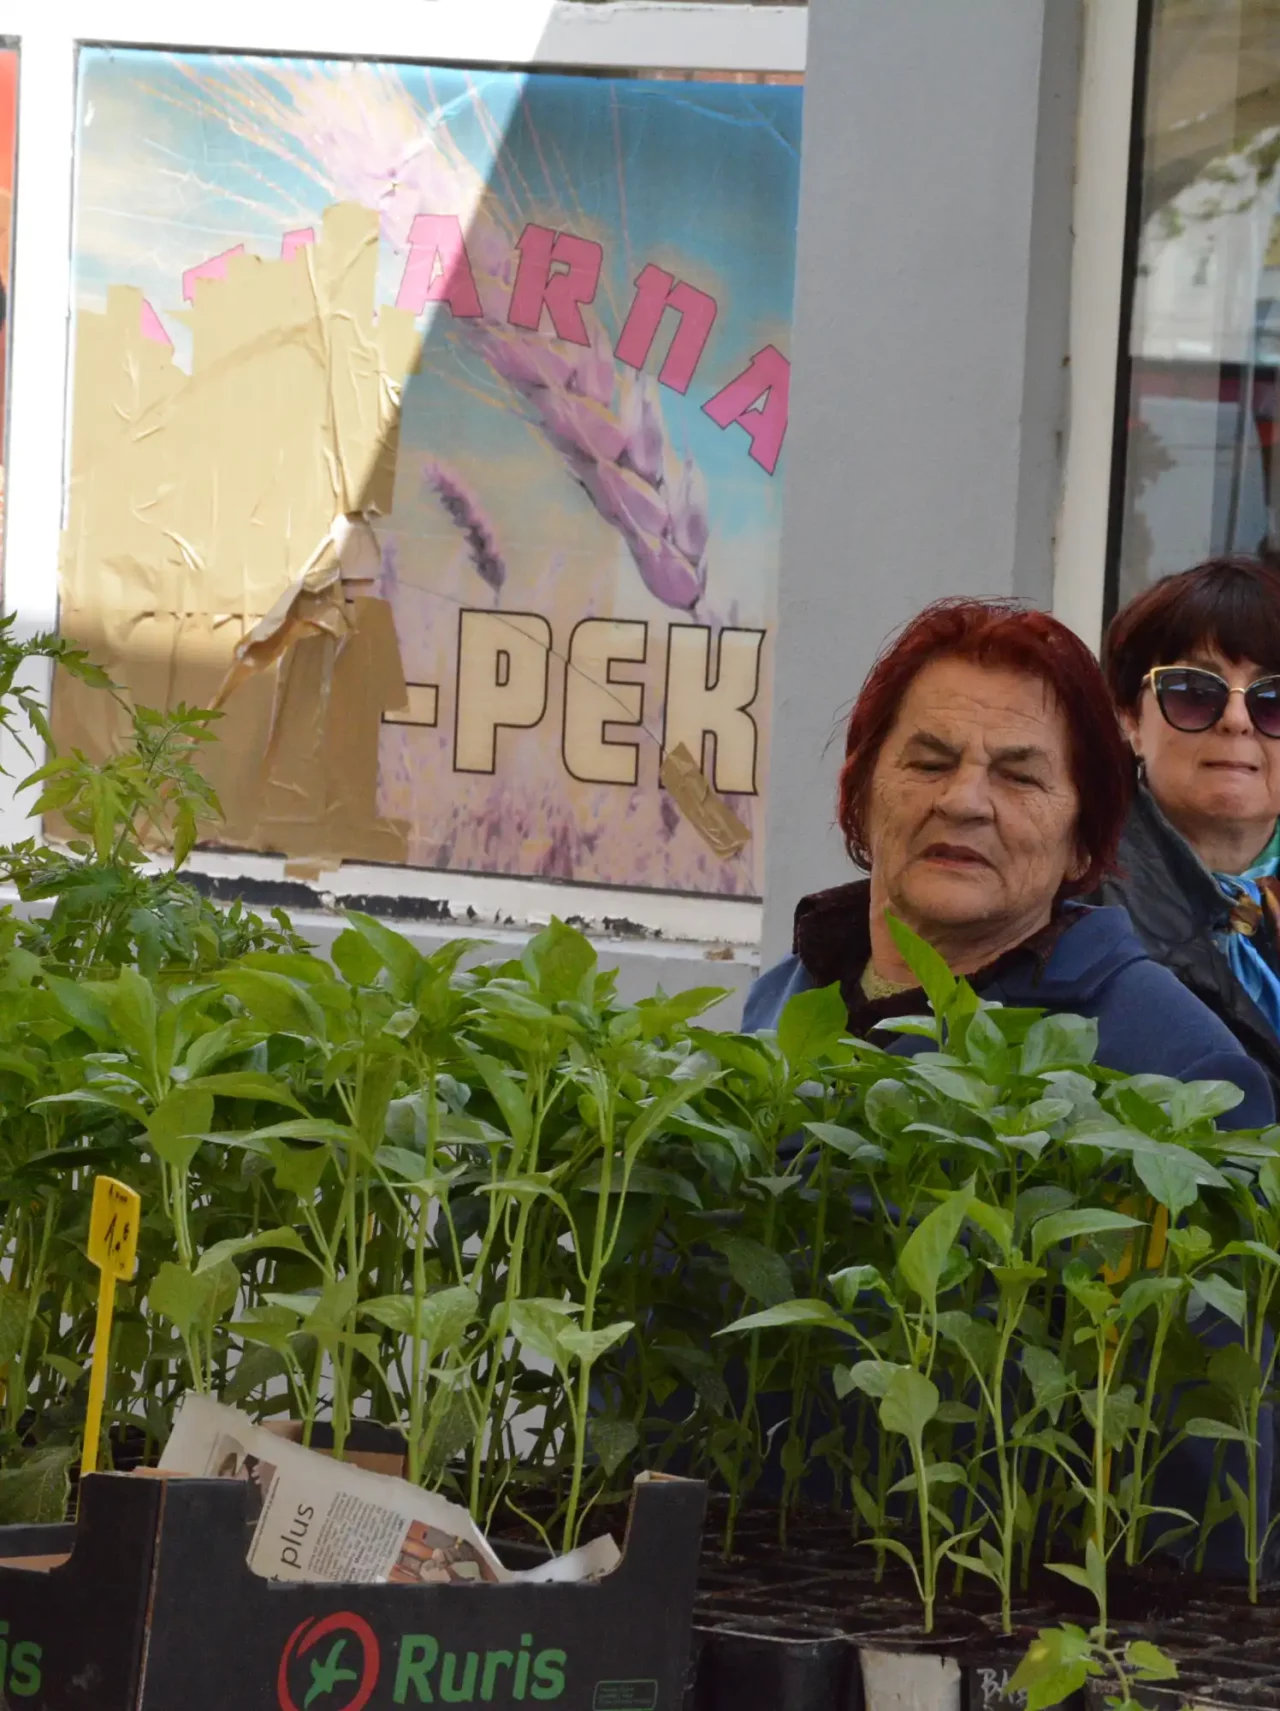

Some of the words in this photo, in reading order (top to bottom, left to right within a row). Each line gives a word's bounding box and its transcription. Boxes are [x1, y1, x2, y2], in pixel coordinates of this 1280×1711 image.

[140, 213, 790, 476] ARNA
[280, 1503, 315, 1570] plus
[392, 1632, 569, 1705] Ruris
